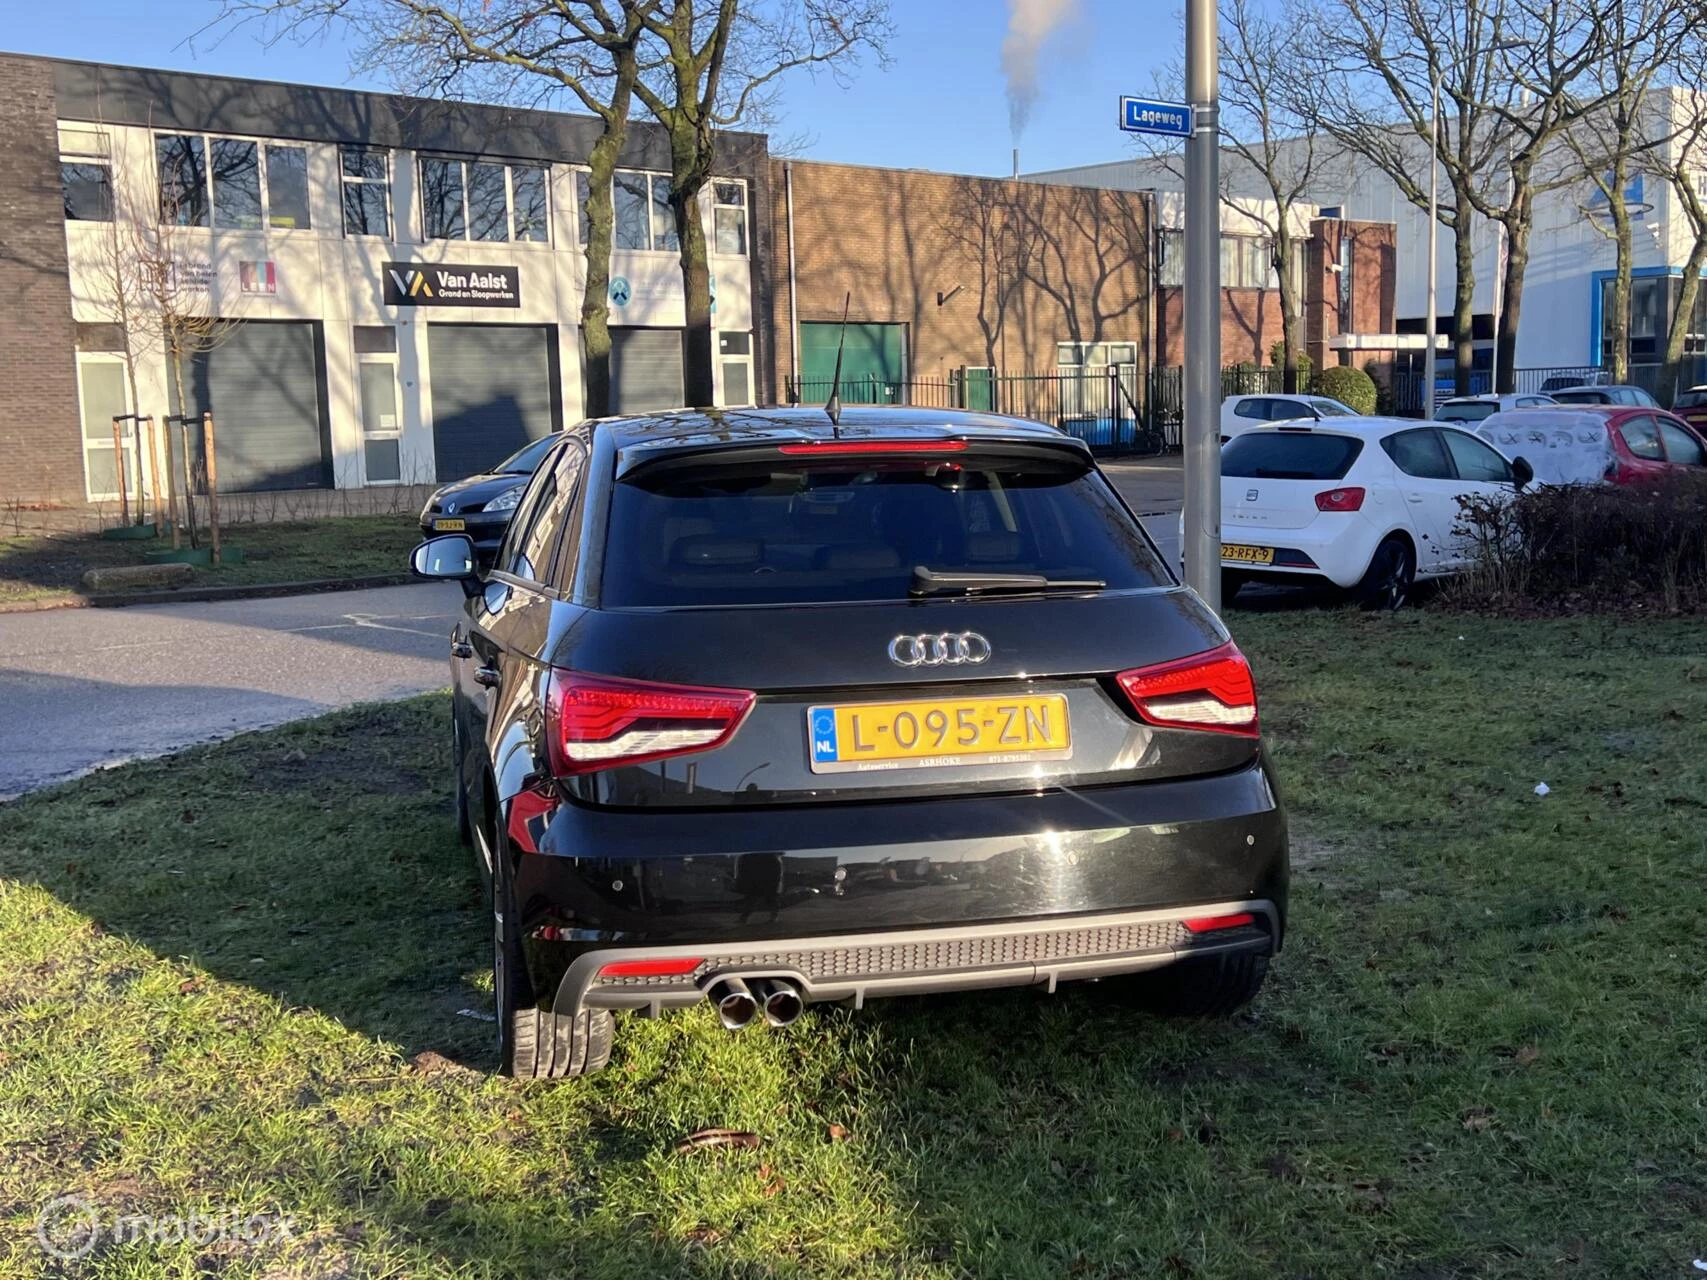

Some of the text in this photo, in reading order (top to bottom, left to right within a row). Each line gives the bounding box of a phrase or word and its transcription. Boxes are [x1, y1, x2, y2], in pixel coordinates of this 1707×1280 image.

[1133, 105, 1183, 130] Lageweg
[436, 270, 508, 289] Van Aalst
[438, 289, 461, 298] Grond
[471, 289, 514, 300] Sloopwerken
[1222, 546, 1269, 561] 23-RFX-9
[852, 704, 1052, 751] L-095-ZN
[817, 740, 834, 753] NL
